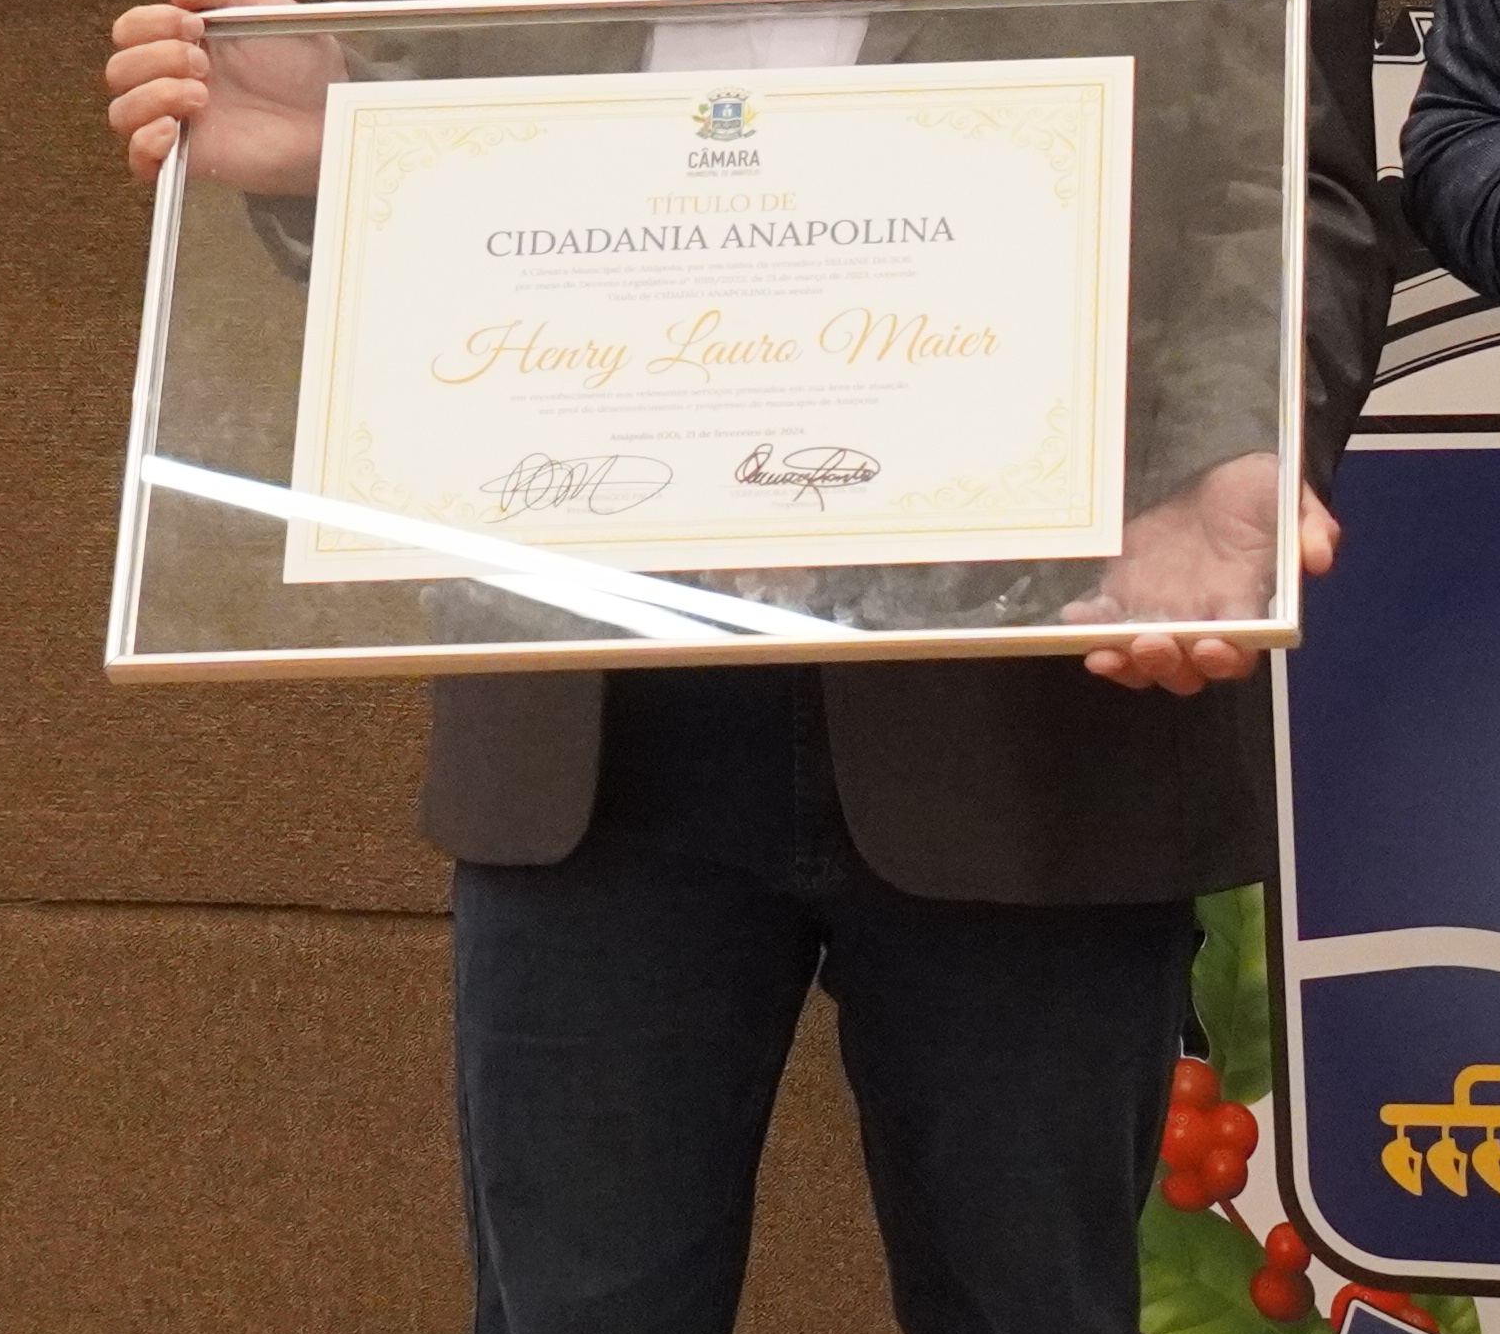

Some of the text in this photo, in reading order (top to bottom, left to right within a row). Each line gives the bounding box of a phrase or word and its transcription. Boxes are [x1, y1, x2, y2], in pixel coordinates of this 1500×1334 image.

[688, 147, 760, 168] CÂMARA
[647, 192, 797, 216] TÍTULO DE
[486, 216, 956, 258] CIDADANIA ANAPOLINA
[432, 307, 1001, 388] Henry Lauro Maier
